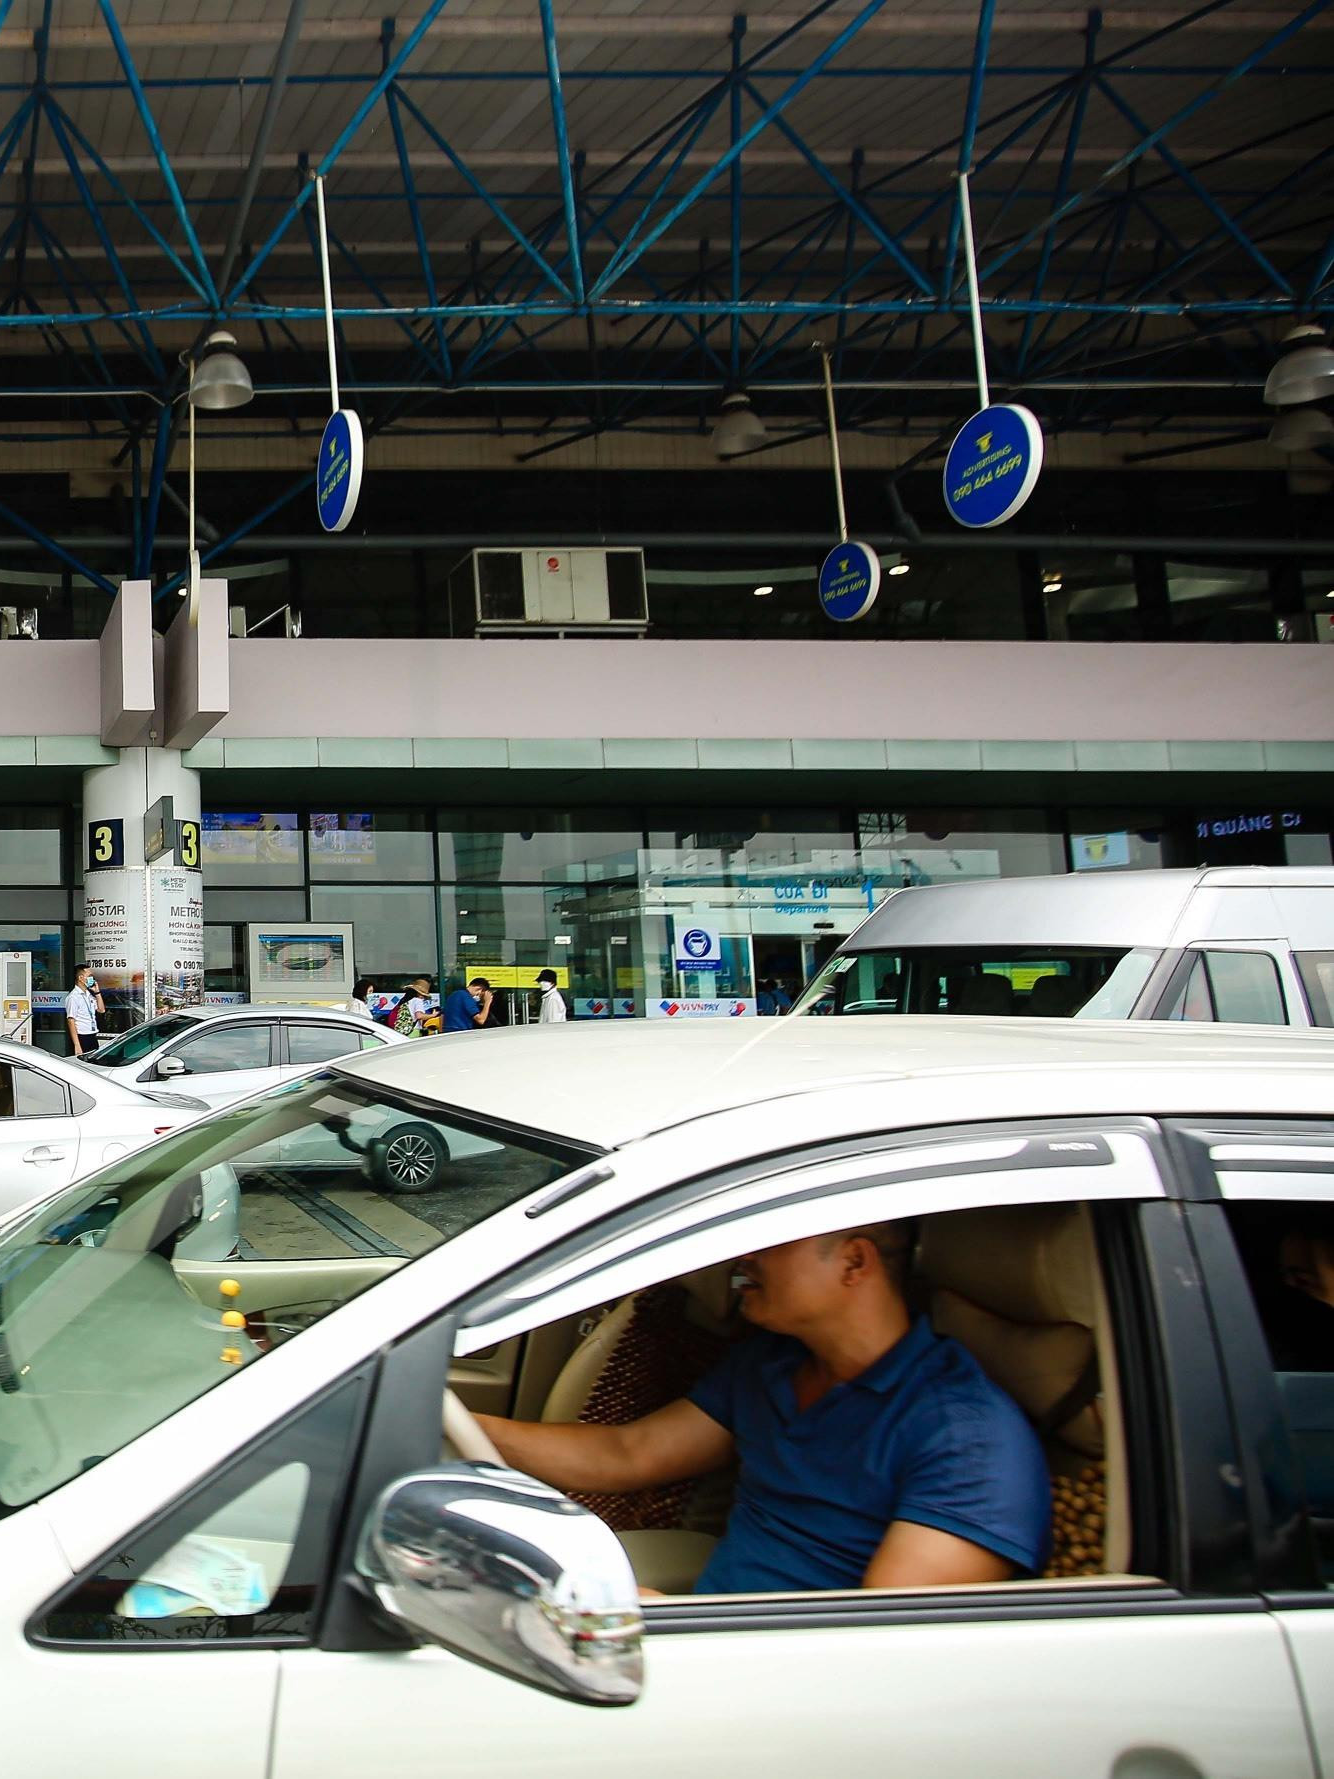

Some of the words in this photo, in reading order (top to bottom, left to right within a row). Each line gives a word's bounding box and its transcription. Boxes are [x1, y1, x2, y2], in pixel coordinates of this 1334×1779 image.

[95, 826, 113, 861] 3
[182, 823, 197, 866] 3
[861, 880, 875, 914] 1
[98, 904, 126, 916] STAR
[170, 906, 200, 918] METRO
[775, 904, 830, 916] Departure
[104, 959, 114, 968] 65
[115, 959, 127, 968] 65
[183, 961, 195, 969] 090
[691, 1003, 720, 1011] VNPAY
